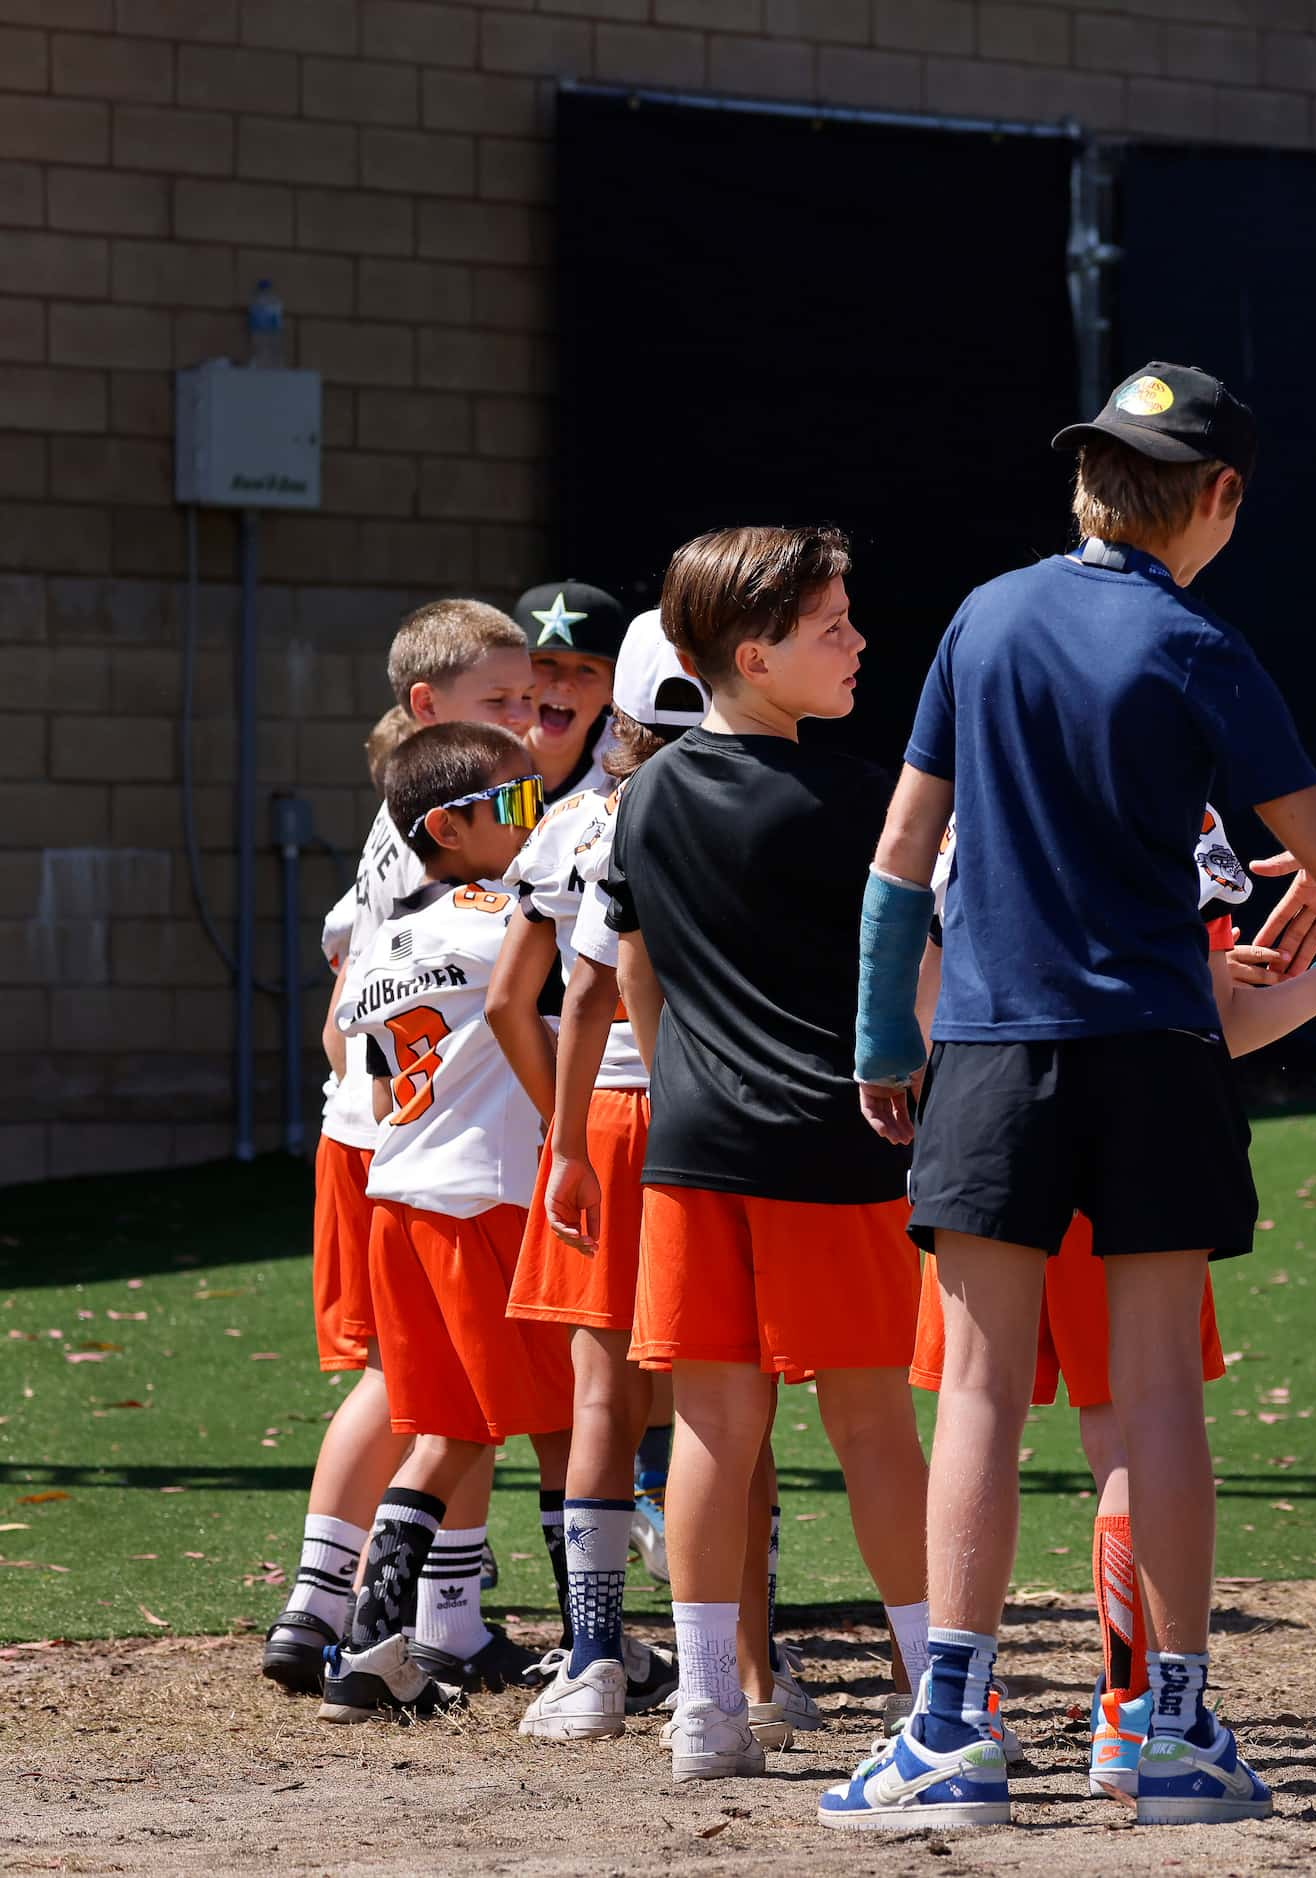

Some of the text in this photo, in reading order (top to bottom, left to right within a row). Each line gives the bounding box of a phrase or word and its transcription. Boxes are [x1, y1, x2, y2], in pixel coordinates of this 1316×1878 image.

[384, 1005, 452, 1127] 8
[437, 1600, 468, 1610] adidas
[1150, 1743, 1177, 1755] NIKE
